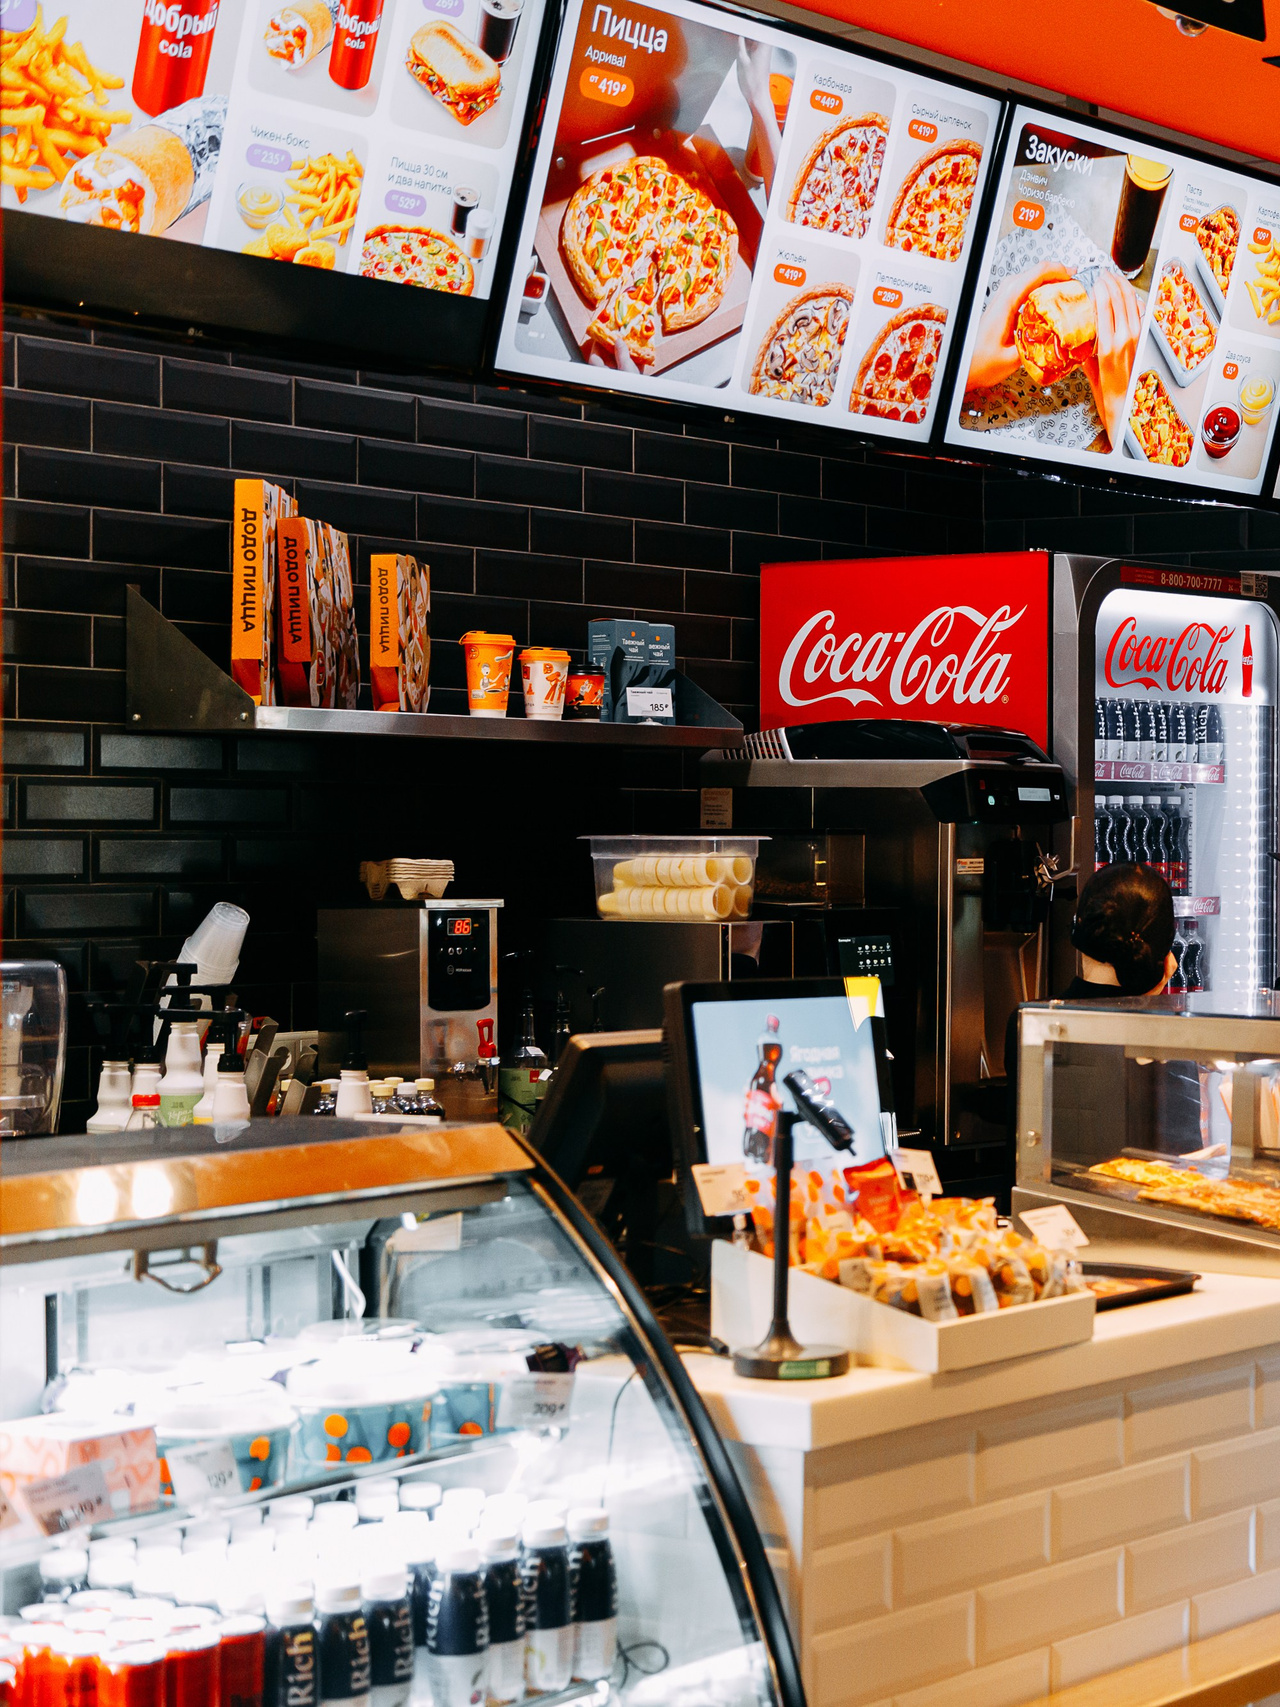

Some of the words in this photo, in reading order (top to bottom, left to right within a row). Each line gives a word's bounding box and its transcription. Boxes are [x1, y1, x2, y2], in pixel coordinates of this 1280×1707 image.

[345, 37, 365, 50] cola
[591, 4, 668, 54] Пицца
[159, 39, 192, 58] cola
[585, 45, 627, 68] Аррива!
[813, 74, 853, 94] Карбонара
[911, 103, 939, 119] Сырный
[939, 114, 973, 130] цыпленок
[250, 125, 311, 149] Чикен-бокс
[391, 156, 422, 174] Пицца
[423, 163, 435, 175] 30
[436, 169, 449, 180] см
[1025, 135, 1094, 177] Закуски
[388, 174, 396, 182] и
[396, 175, 413, 187] два
[414, 181, 452, 195] напитка
[1018, 183, 1044, 200] Чоризо
[1020, 169, 1049, 186] Дэнвич
[1186, 184, 1202, 196] Паста
[777, 249, 807, 264] Жюльен
[875, 271, 913, 290] Пепперони
[914, 281, 933, 294] фреш
[241, 508, 257, 561] ДОДО
[284, 537, 299, 583] ДОДО
[378, 568, 389, 605] ДОДО
[1160, 572, 1223, 591] 8-800-700-7777
[240, 566, 256, 632] ПИЦЦА
[287, 586, 303, 644] ПИЦЦА
[378, 607, 390, 653] ПИЦЦА
[778, 604, 1028, 708] Coca-Cola
[1104, 616, 1237, 694] Coca-Cola
[1159, 708, 1168, 740] Rich
[1177, 709, 1187, 740] Rich
[1198, 707, 1208, 740] Rich
[454, 919, 471, 934] 86
[287, 1631, 314, 1706] Rich
[349, 1617, 370, 1691] Rich
